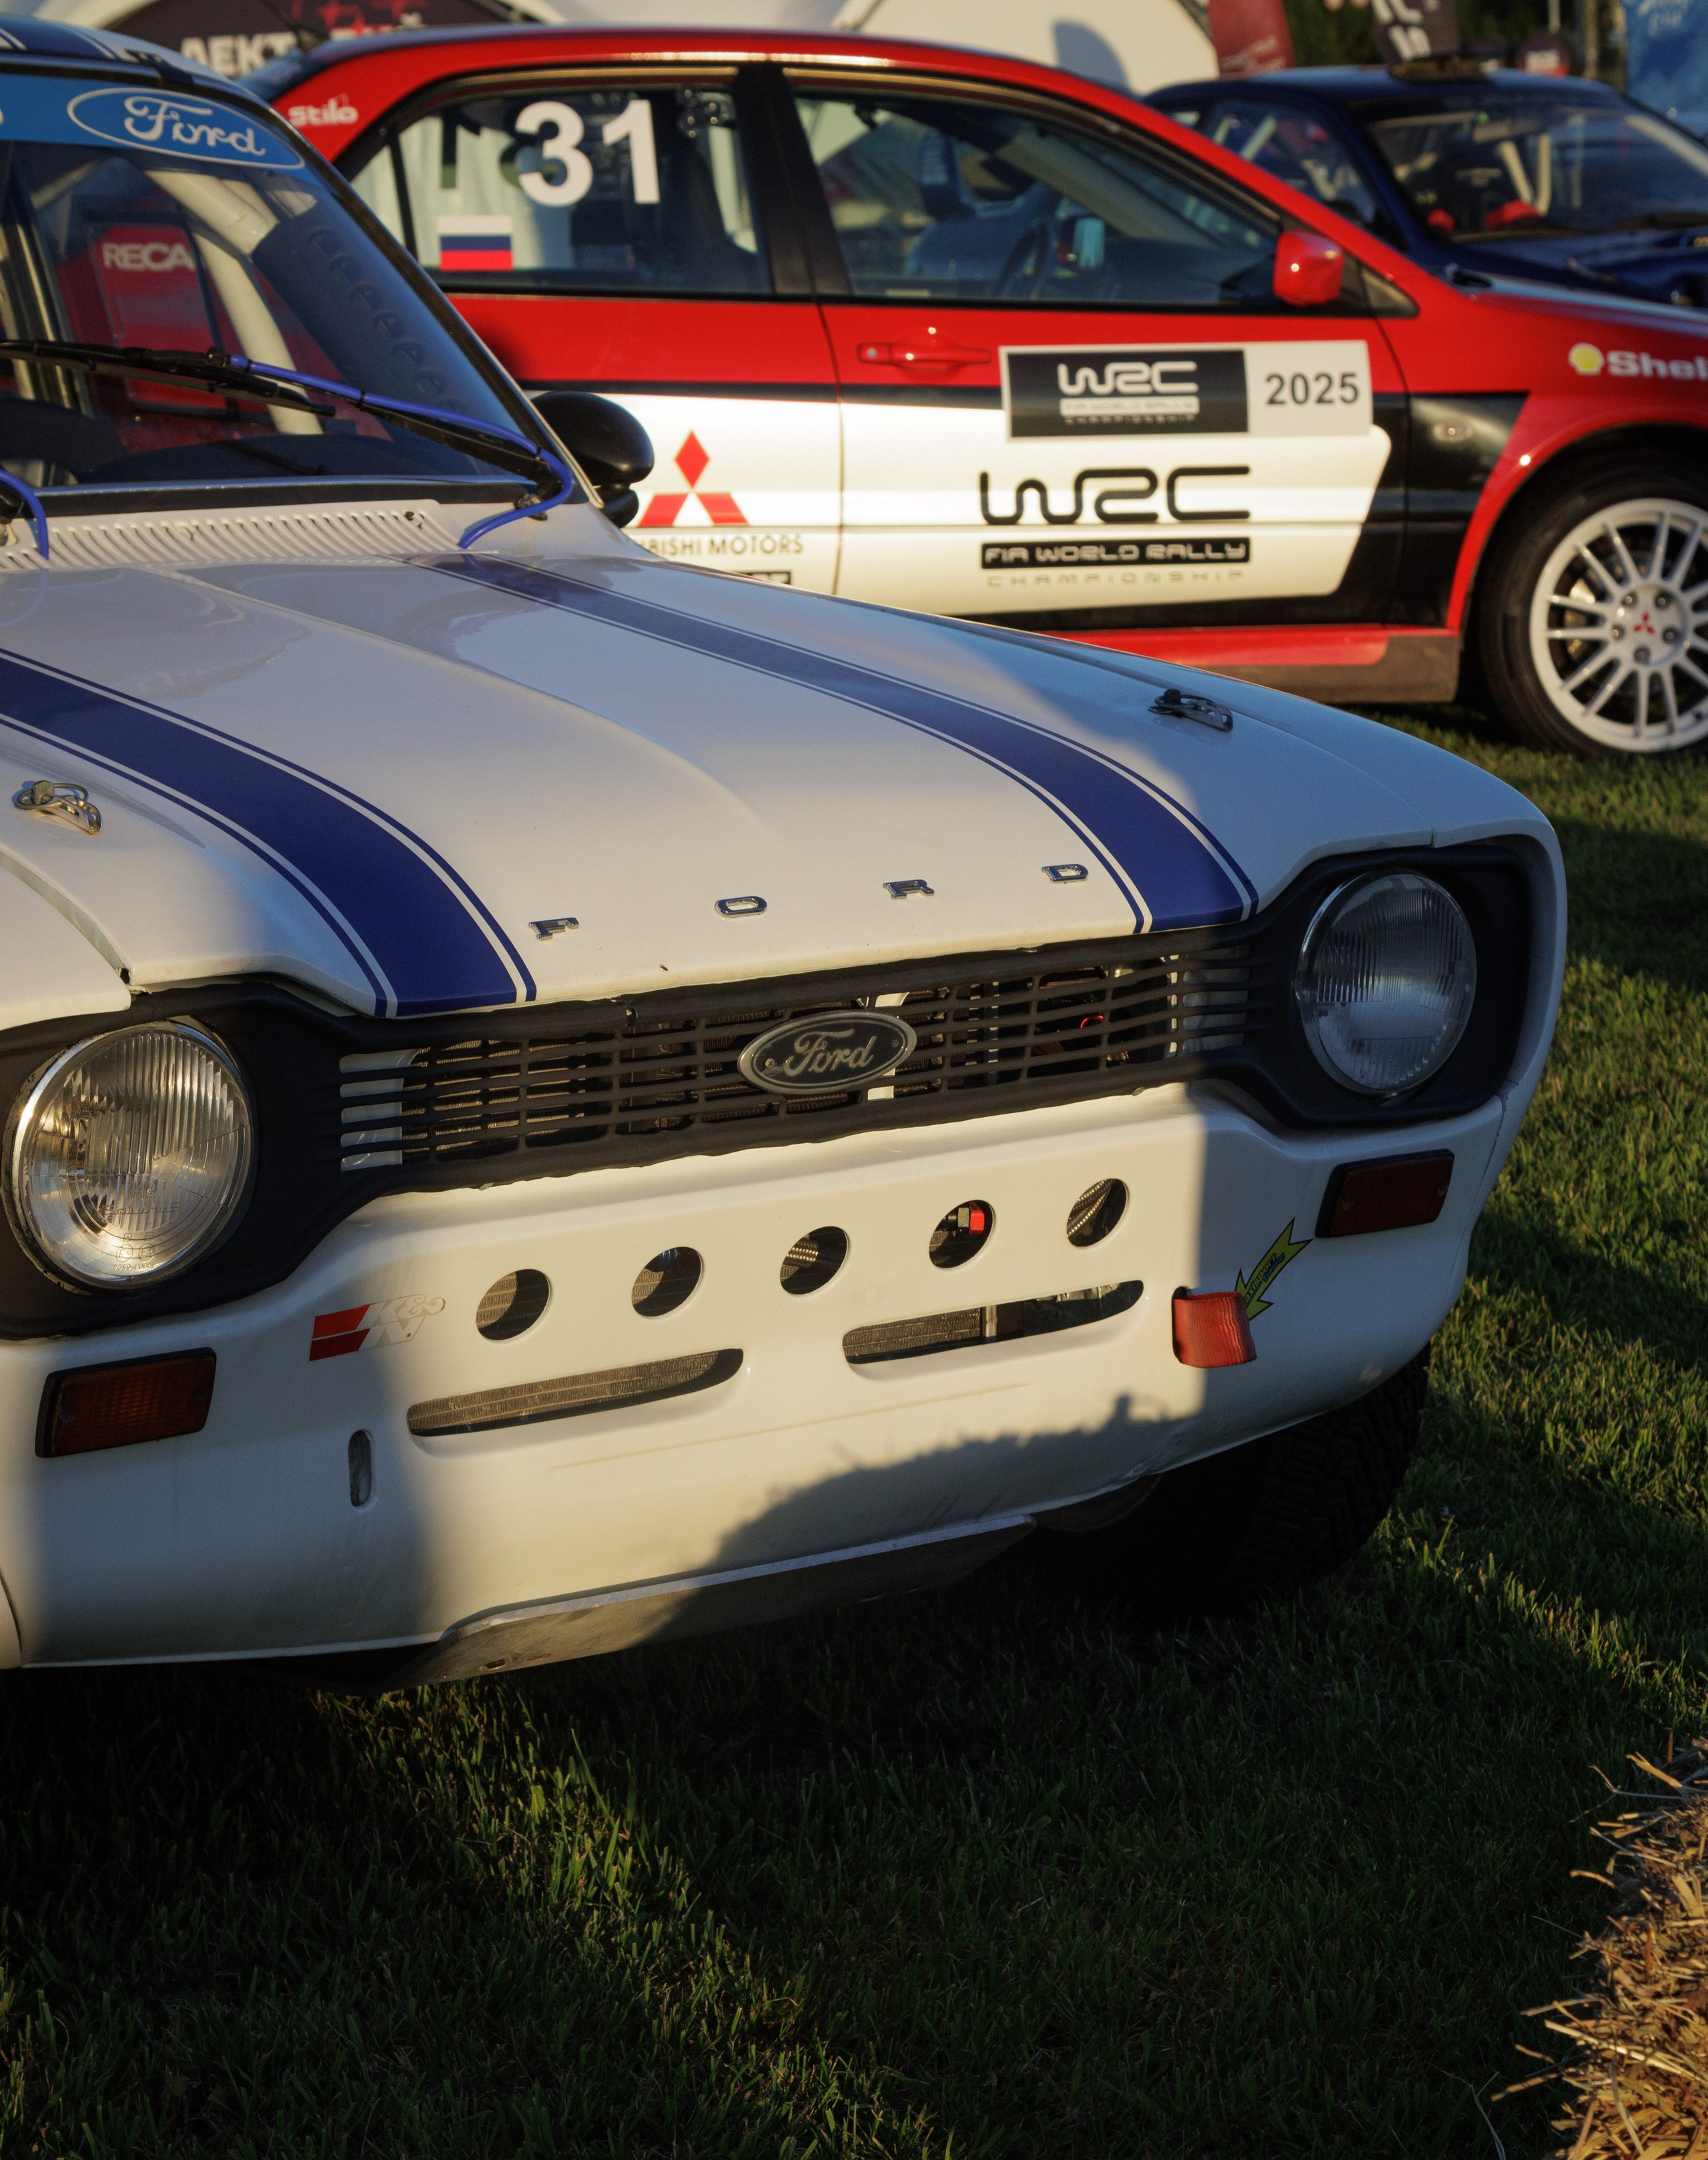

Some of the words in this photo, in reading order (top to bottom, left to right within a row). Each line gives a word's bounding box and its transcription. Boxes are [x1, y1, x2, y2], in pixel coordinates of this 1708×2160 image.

[123, 96, 266, 157] Ford
[515, 99, 661, 207] 31
[1057, 360, 1199, 396] WRC
[1266, 372, 1359, 404] 2025
[979, 466, 1248, 526] WRC
[640, 536, 702, 557] BISHI
[708, 534, 804, 557] MOTORS
[984, 547, 1029, 563] FIA
[1035, 544, 1140, 563] WORLD
[1146, 542, 1246, 560] RALLY
[986, 569, 1246, 588] CHAMPIONSHIP
[783, 1028, 878, 1077] Ford
